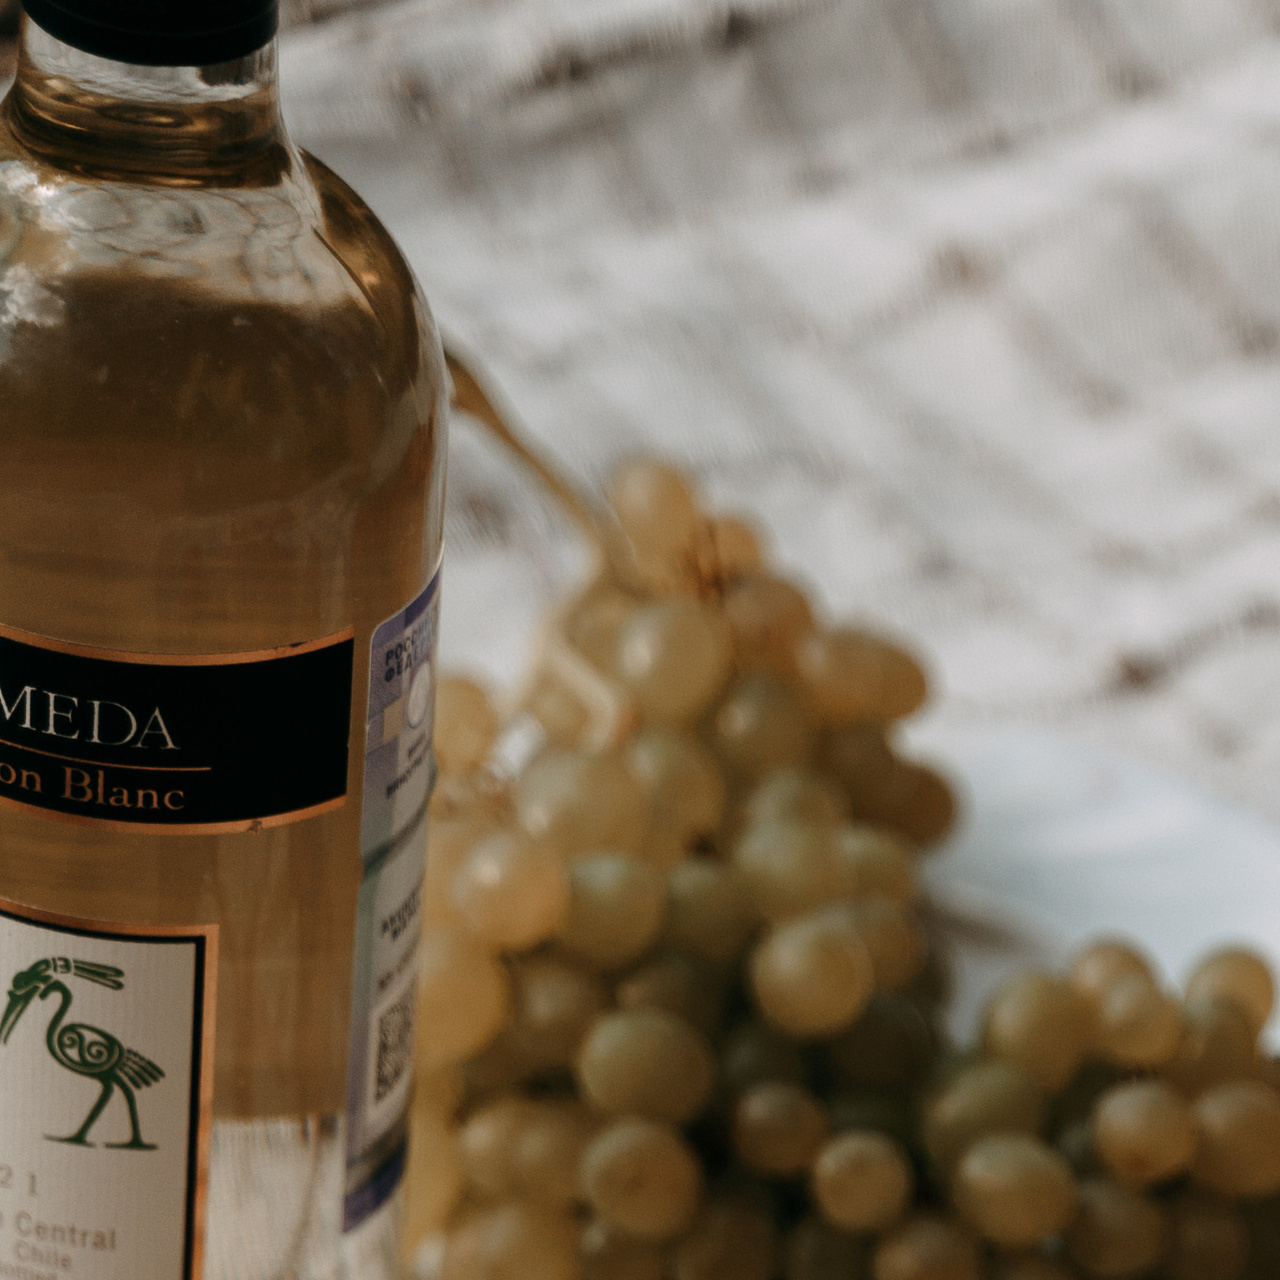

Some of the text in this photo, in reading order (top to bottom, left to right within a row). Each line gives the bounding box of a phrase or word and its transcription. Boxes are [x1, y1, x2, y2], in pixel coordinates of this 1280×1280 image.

[61, 766, 185, 811] Blanc
[15, 1209, 117, 1251] Central
[13, 1239, 72, 1273] Chile
